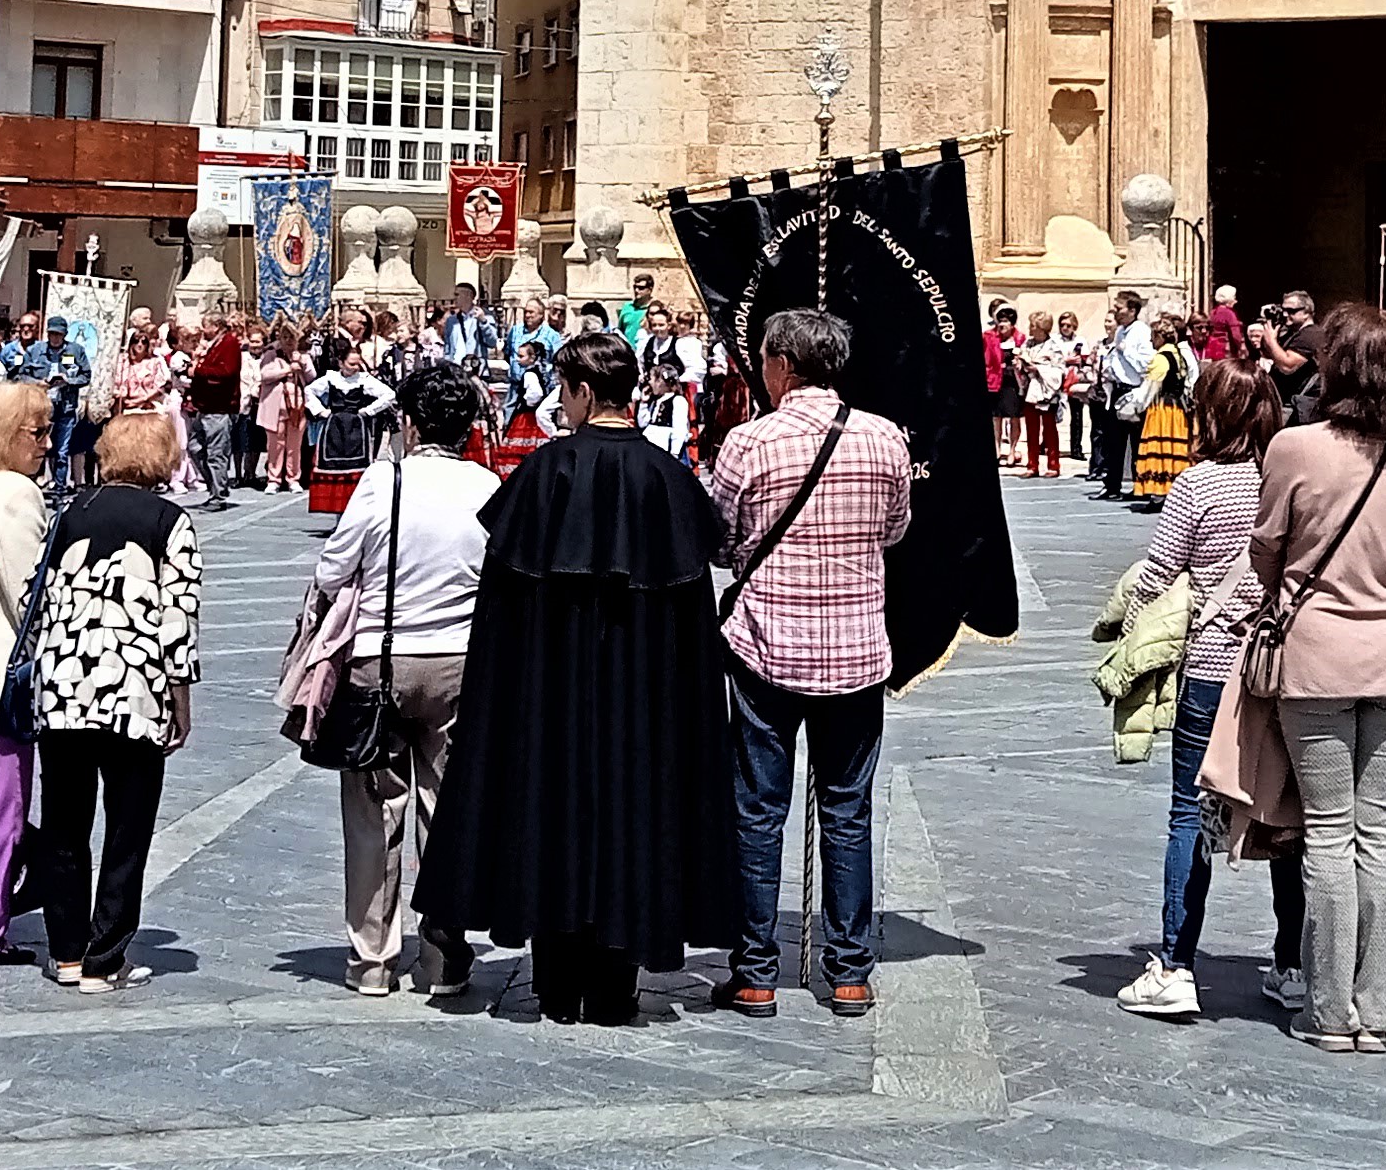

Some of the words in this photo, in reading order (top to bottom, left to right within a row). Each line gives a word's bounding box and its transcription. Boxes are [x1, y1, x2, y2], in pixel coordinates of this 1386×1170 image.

[762, 204, 842, 258] ESCLAVITD
[852, 210, 877, 233] DEL
[878, 228, 915, 268] SANTO
[912, 269, 956, 343] SEPULCRO
